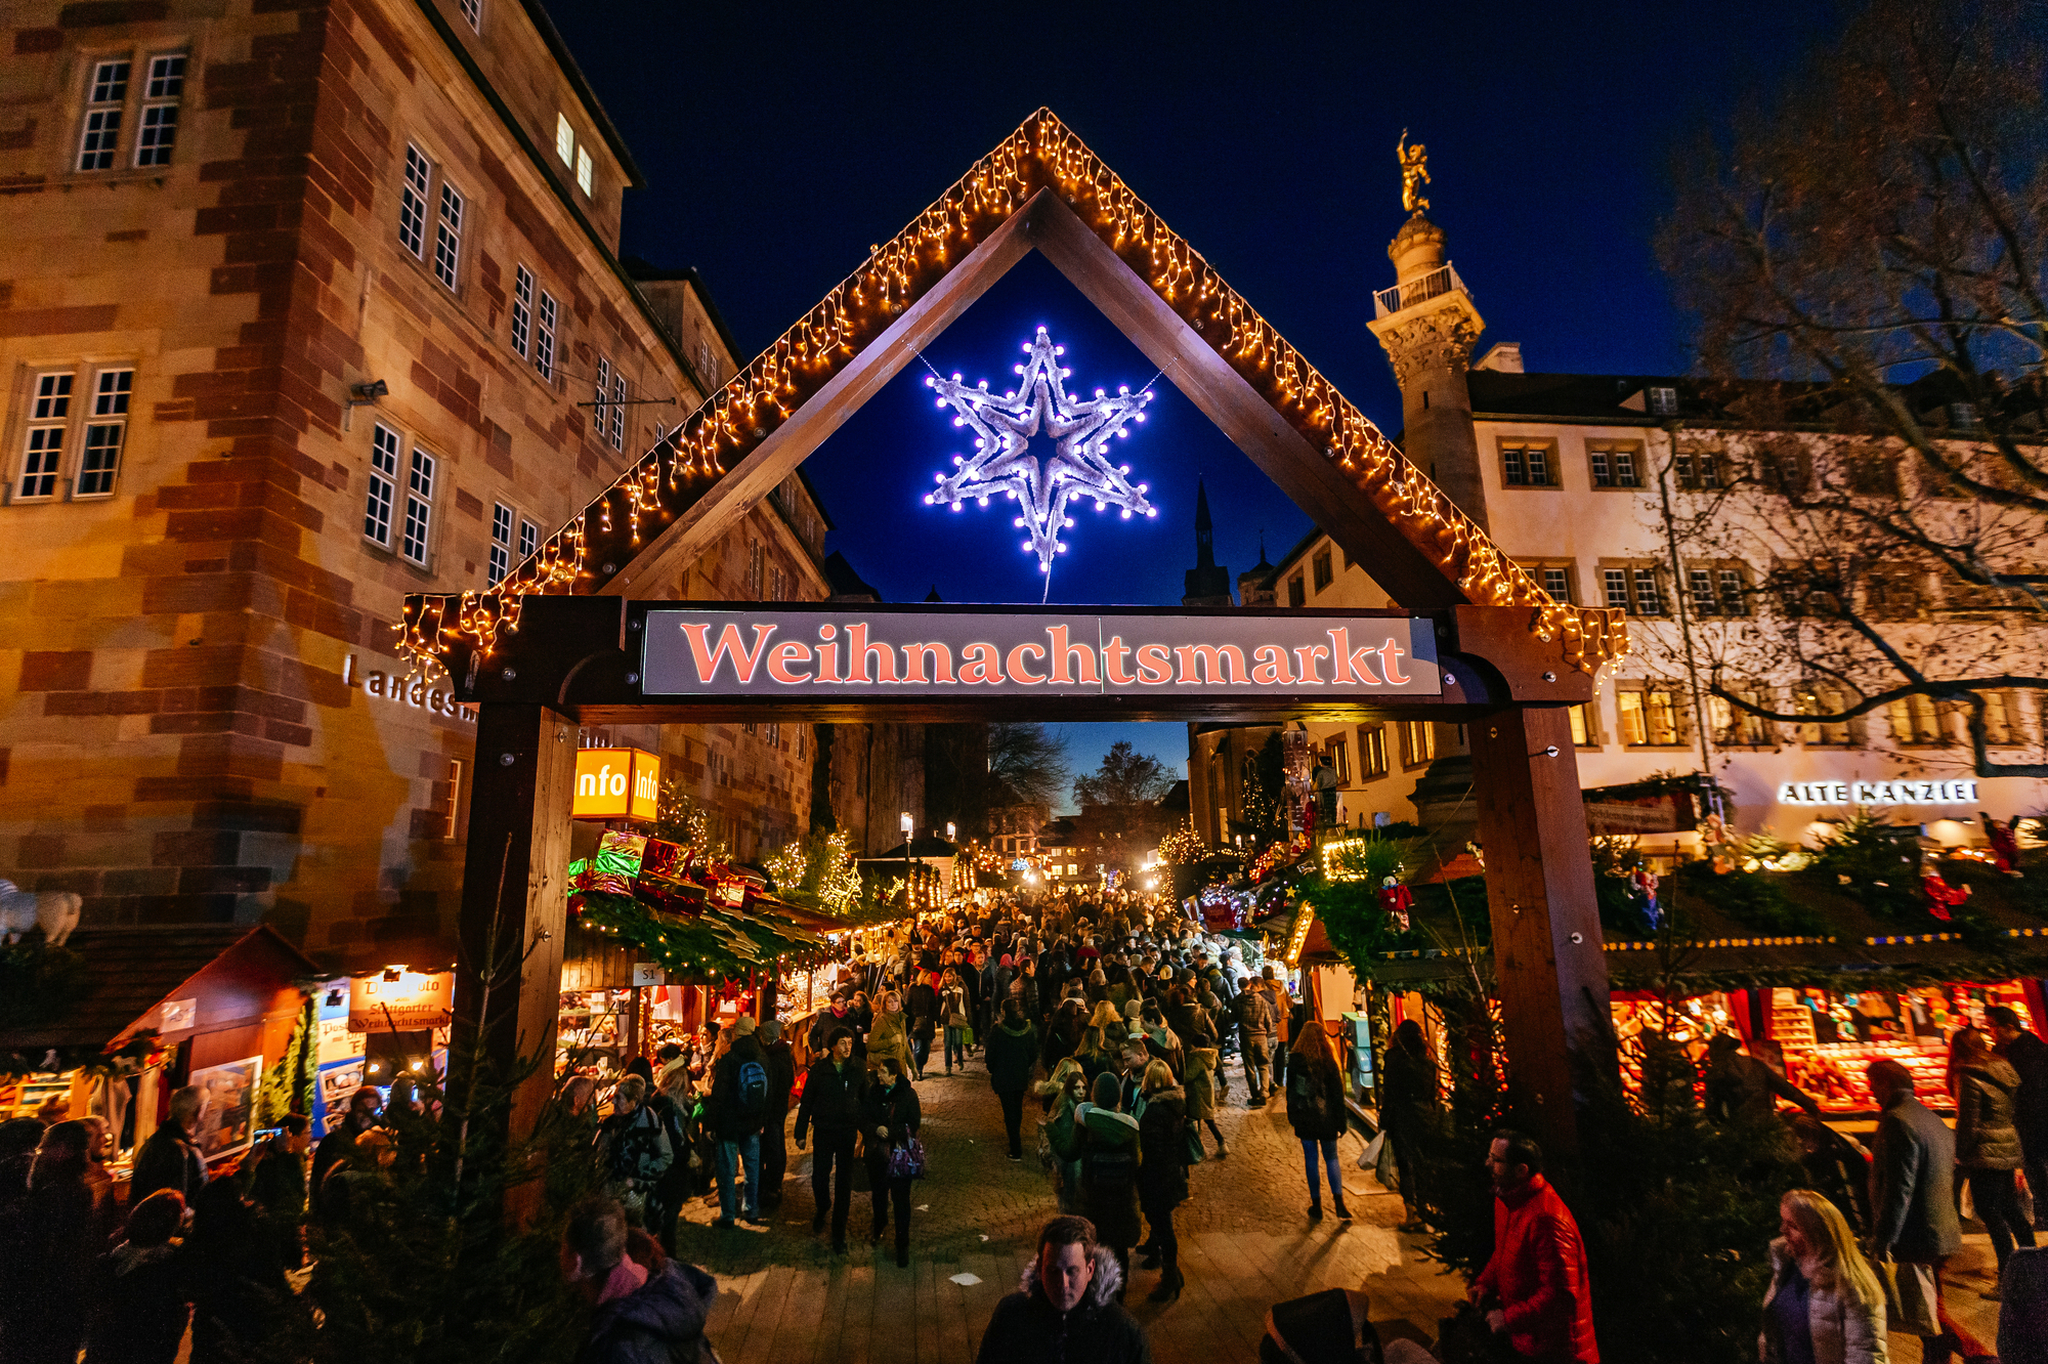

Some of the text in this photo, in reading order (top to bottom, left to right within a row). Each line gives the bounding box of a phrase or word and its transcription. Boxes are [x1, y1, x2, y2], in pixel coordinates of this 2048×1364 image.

[680, 622, 1411, 686] Weihnachtsmarkt
[574, 764, 626, 797] nfo
[635, 769, 658, 801] Info
[1781, 781, 1979, 802] ALTE KANZLEI
[642, 969, 655, 980] S1
